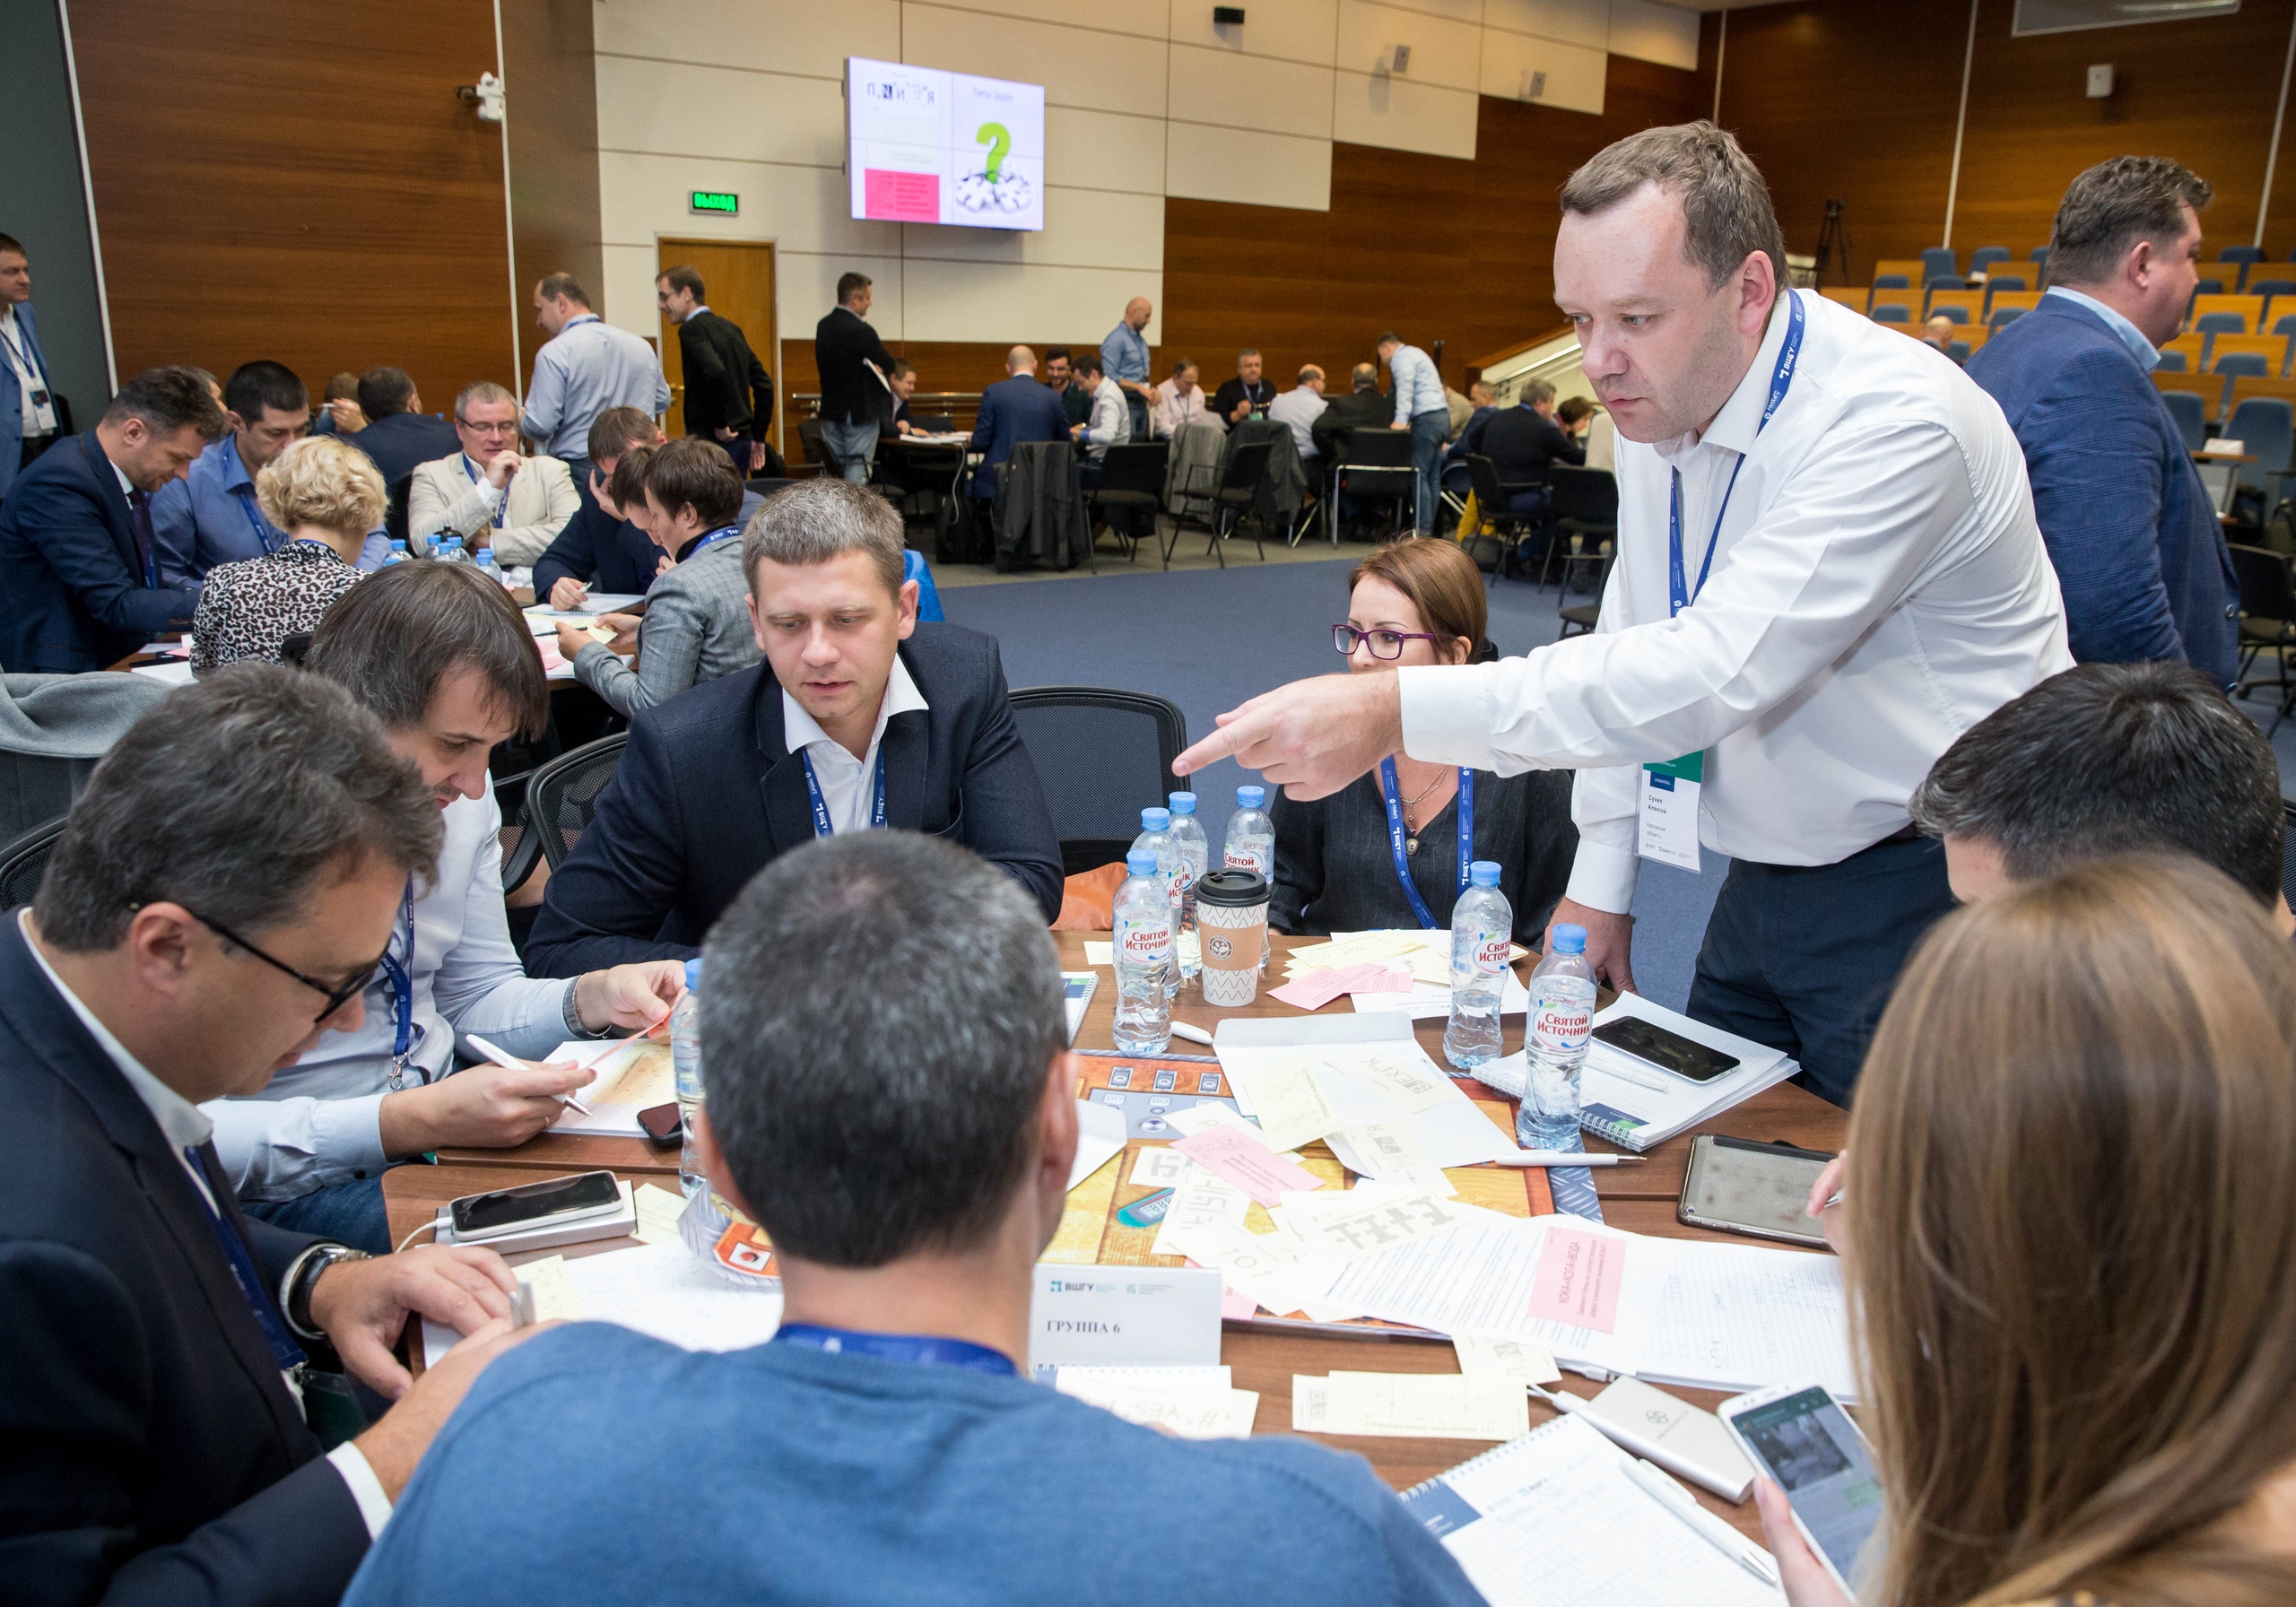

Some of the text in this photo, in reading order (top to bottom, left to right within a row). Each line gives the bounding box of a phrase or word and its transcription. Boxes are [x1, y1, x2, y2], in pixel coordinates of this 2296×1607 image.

[694, 193, 736, 212] ВЫХОД
[1784, 347, 1795, 369] ВШГУ
[1648, 804, 1666, 814] Алексей
[1646, 822, 1666, 831] Кировская
[1132, 926, 1169, 942] Святой
[1545, 1013, 1588, 1026] Святой
[1065, 1282, 1094, 1292] ВШГУ
[1047, 1319, 1121, 1334] ГРУППА 6
